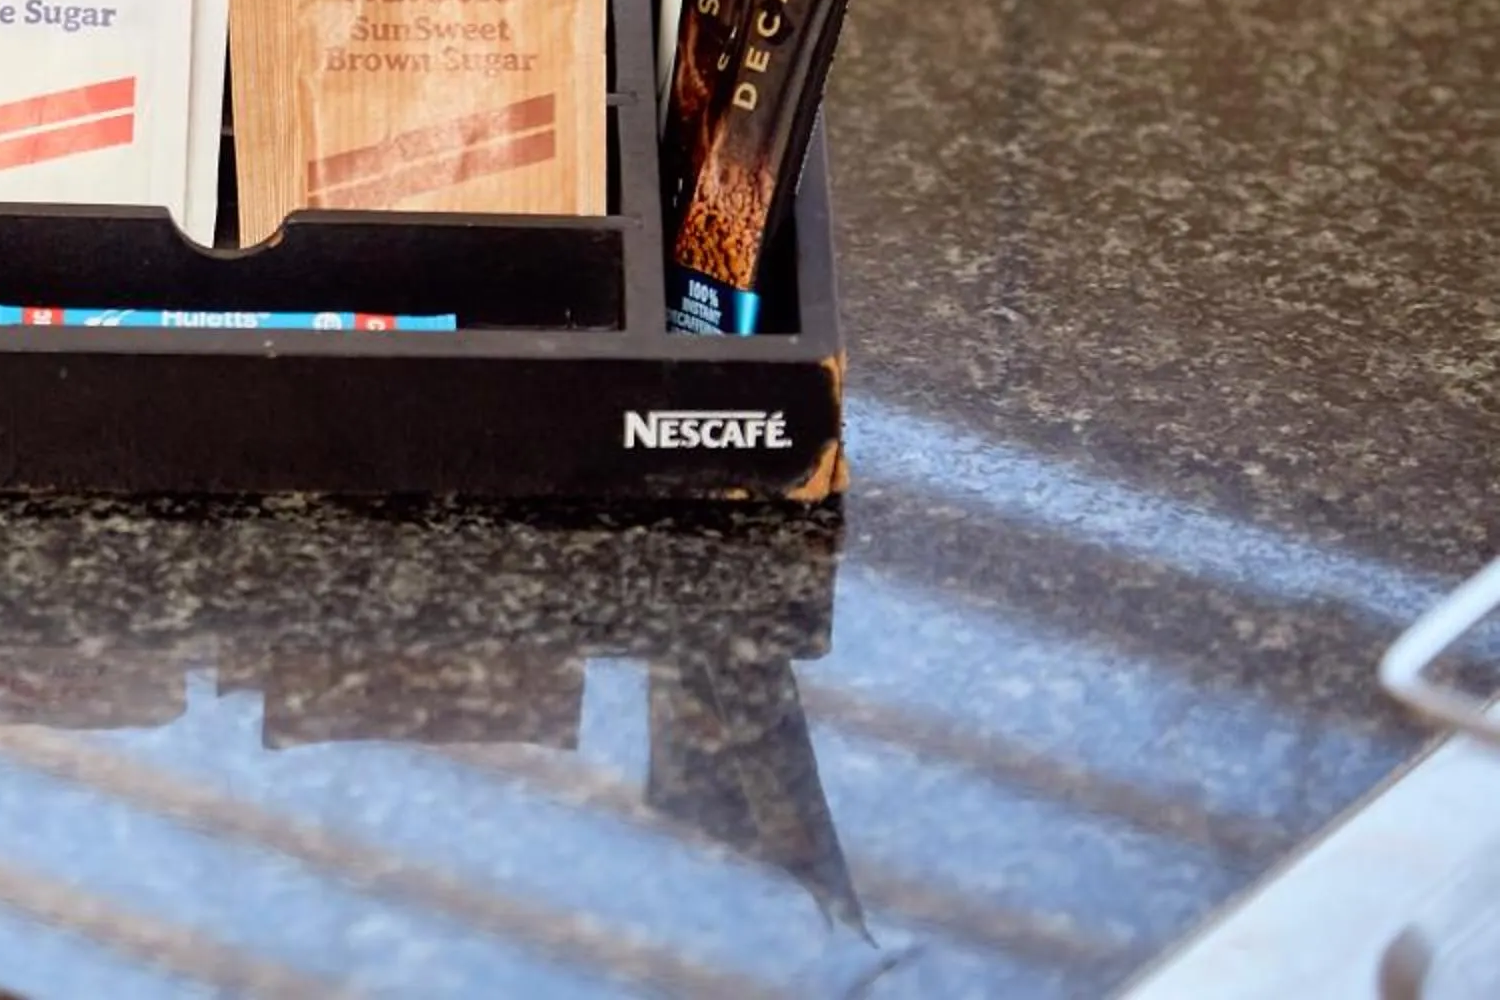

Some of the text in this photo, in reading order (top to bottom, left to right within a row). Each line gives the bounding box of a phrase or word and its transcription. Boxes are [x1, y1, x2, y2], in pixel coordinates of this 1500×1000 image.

[351, 14, 511, 42] SunSweet
[325, 45, 539, 78] Brown Sugar
[689, 279, 719, 308] 100%
[623, 410, 788, 449] NESCAFÉ
